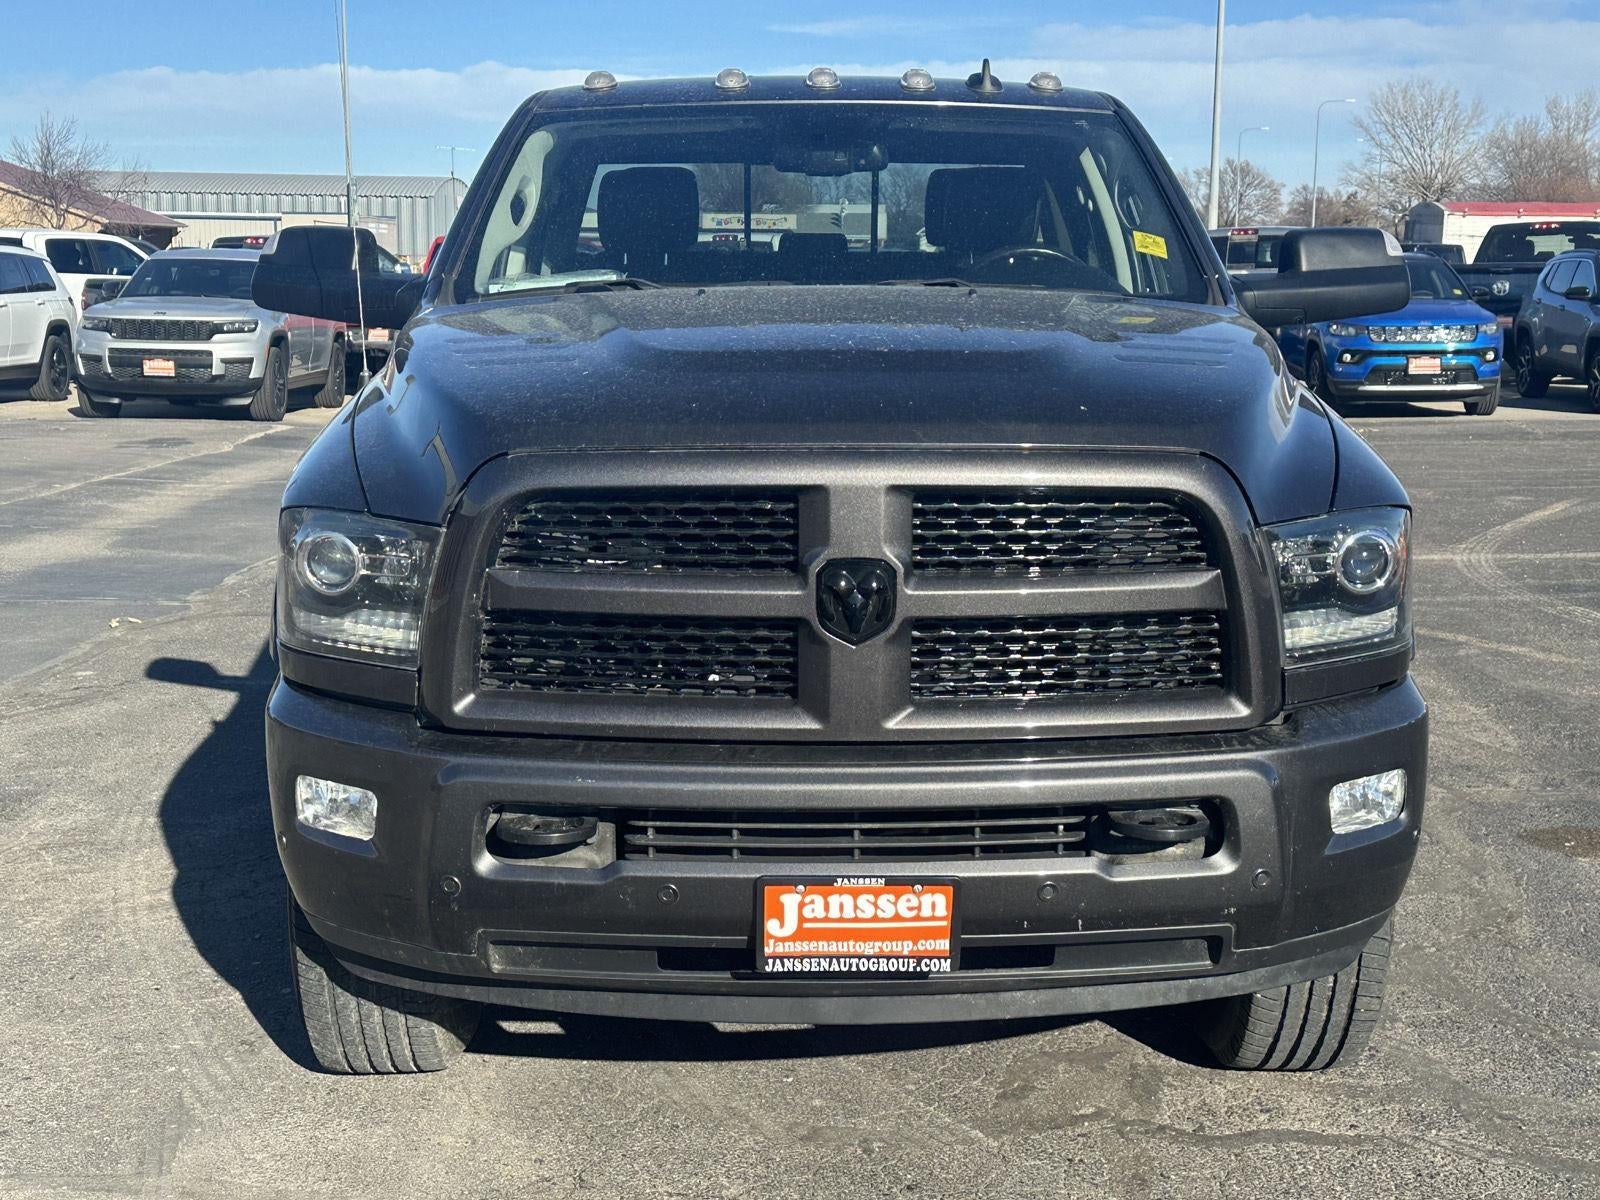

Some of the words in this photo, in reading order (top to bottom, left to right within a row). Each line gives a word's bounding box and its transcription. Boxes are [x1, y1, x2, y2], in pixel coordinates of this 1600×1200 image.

[833, 877, 885, 886] JANSSEN
[766, 893, 948, 938] Janssen
[765, 938, 949, 955] Janssenautogroup.com
[765, 958, 951, 972] JANSSENAUTOGROUP.COM
